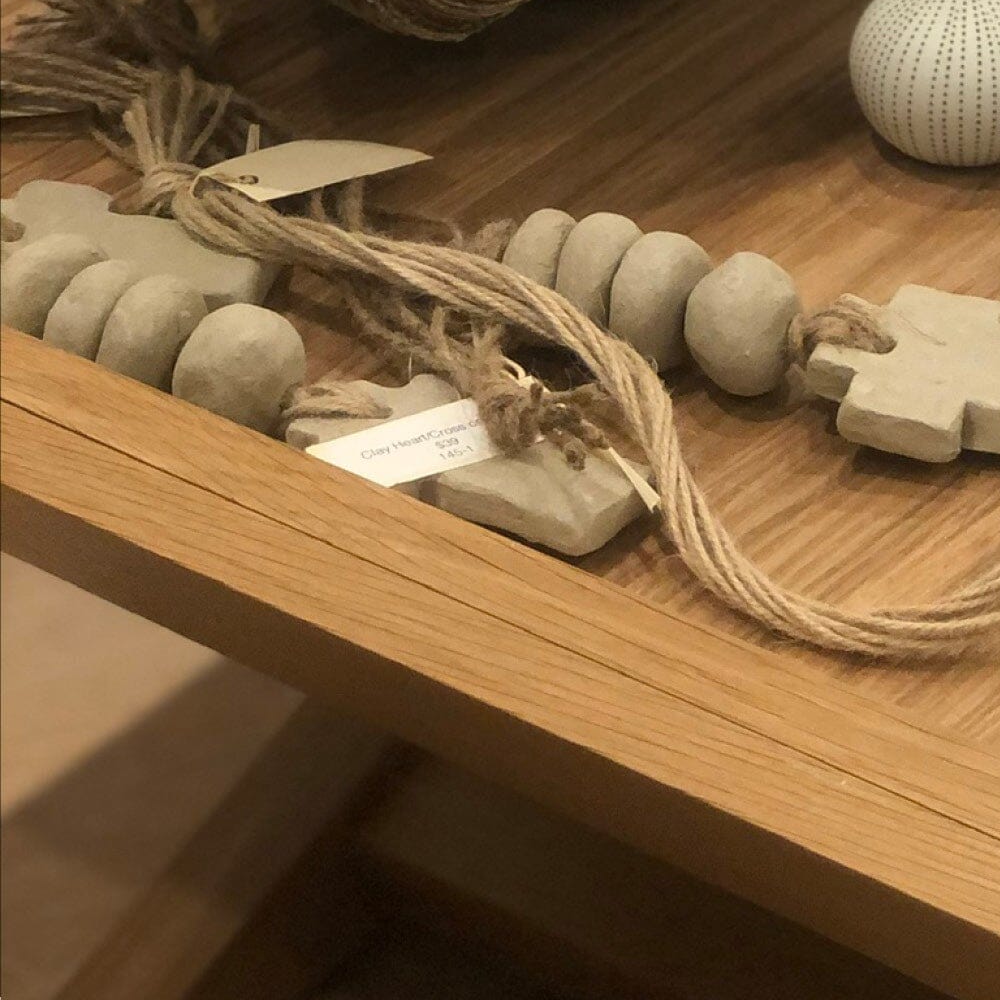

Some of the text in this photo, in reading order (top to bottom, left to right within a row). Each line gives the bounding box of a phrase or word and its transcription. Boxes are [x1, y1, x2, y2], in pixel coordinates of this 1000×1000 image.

[361, 444, 391, 460] Clay
[391, 423, 467, 450] Heart/Cross
[434, 437, 459, 449] $39
[439, 445, 474, 460] 145-1
